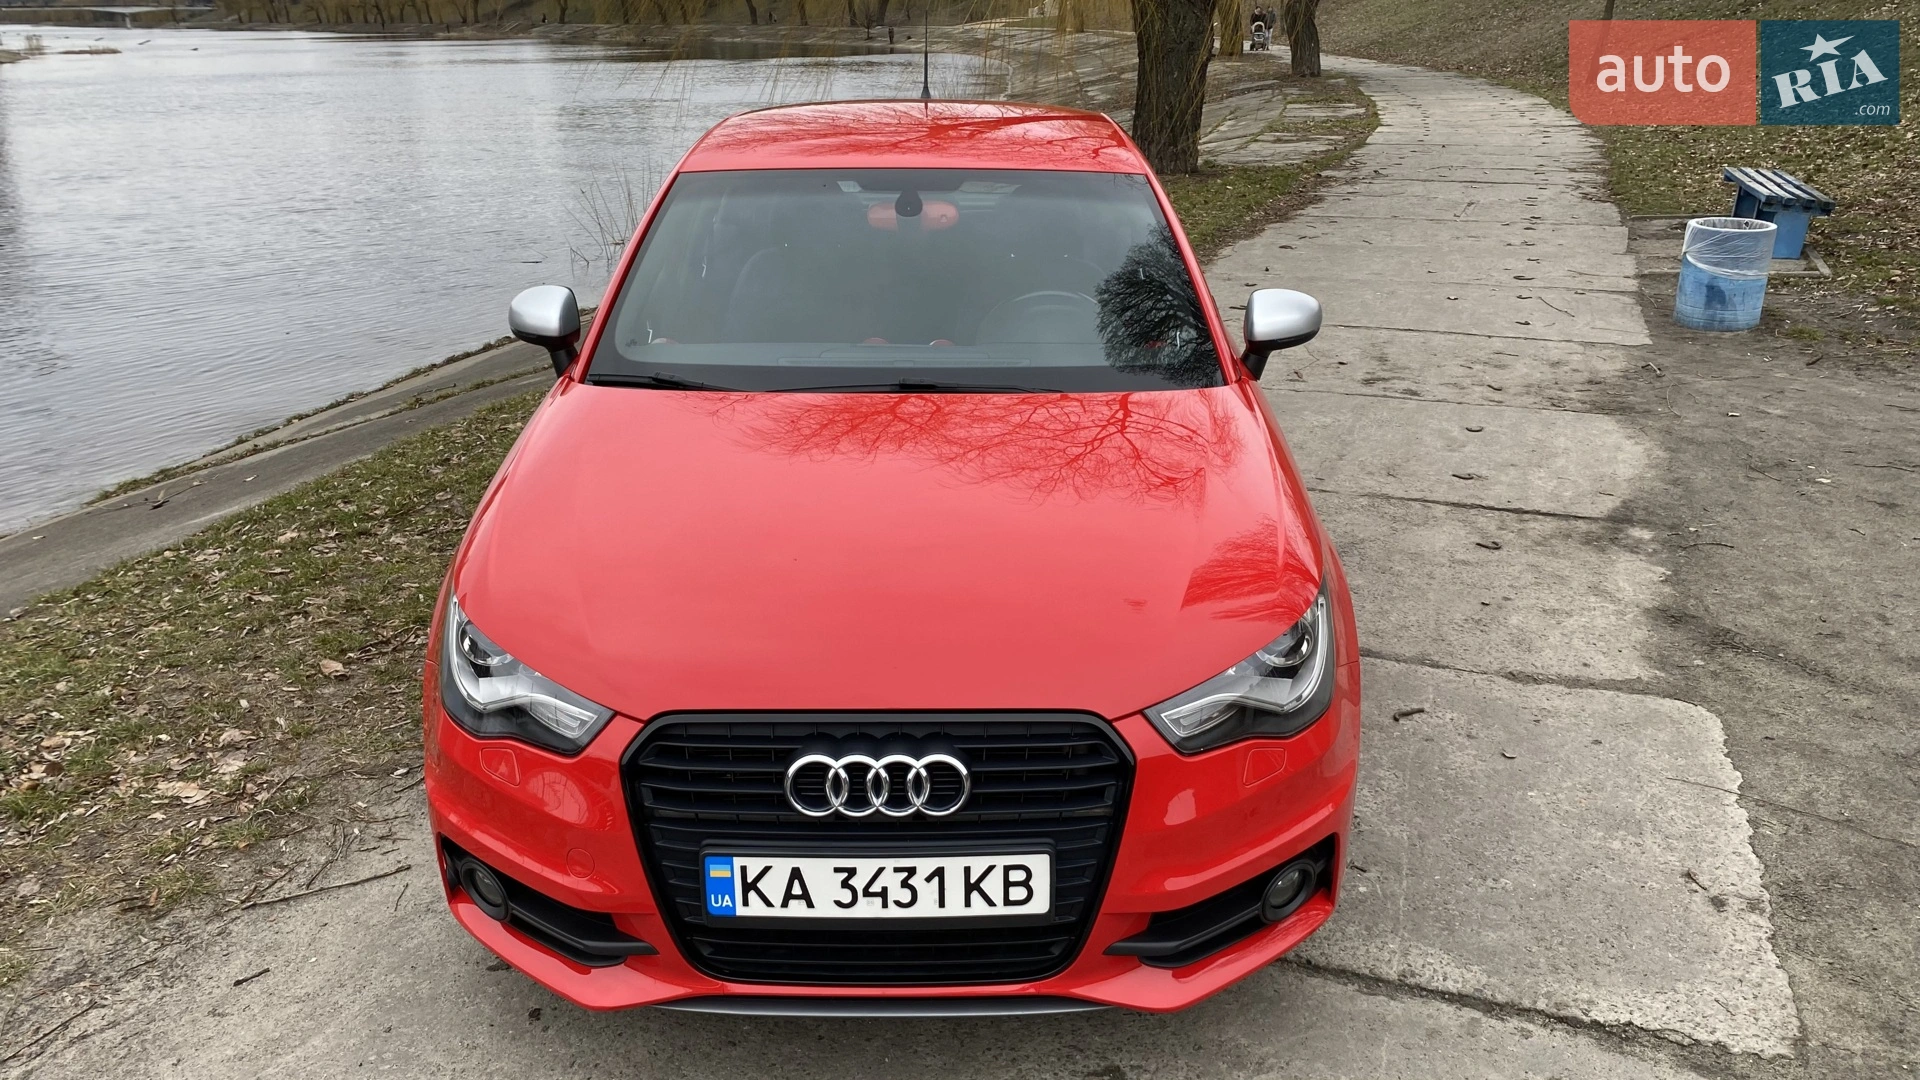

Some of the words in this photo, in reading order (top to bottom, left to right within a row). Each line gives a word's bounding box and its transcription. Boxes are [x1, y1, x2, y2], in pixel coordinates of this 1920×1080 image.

[710, 894, 734, 908] UA
[740, 865, 815, 908] KA
[833, 866, 946, 909] 3431
[963, 864, 1035, 908] KB
